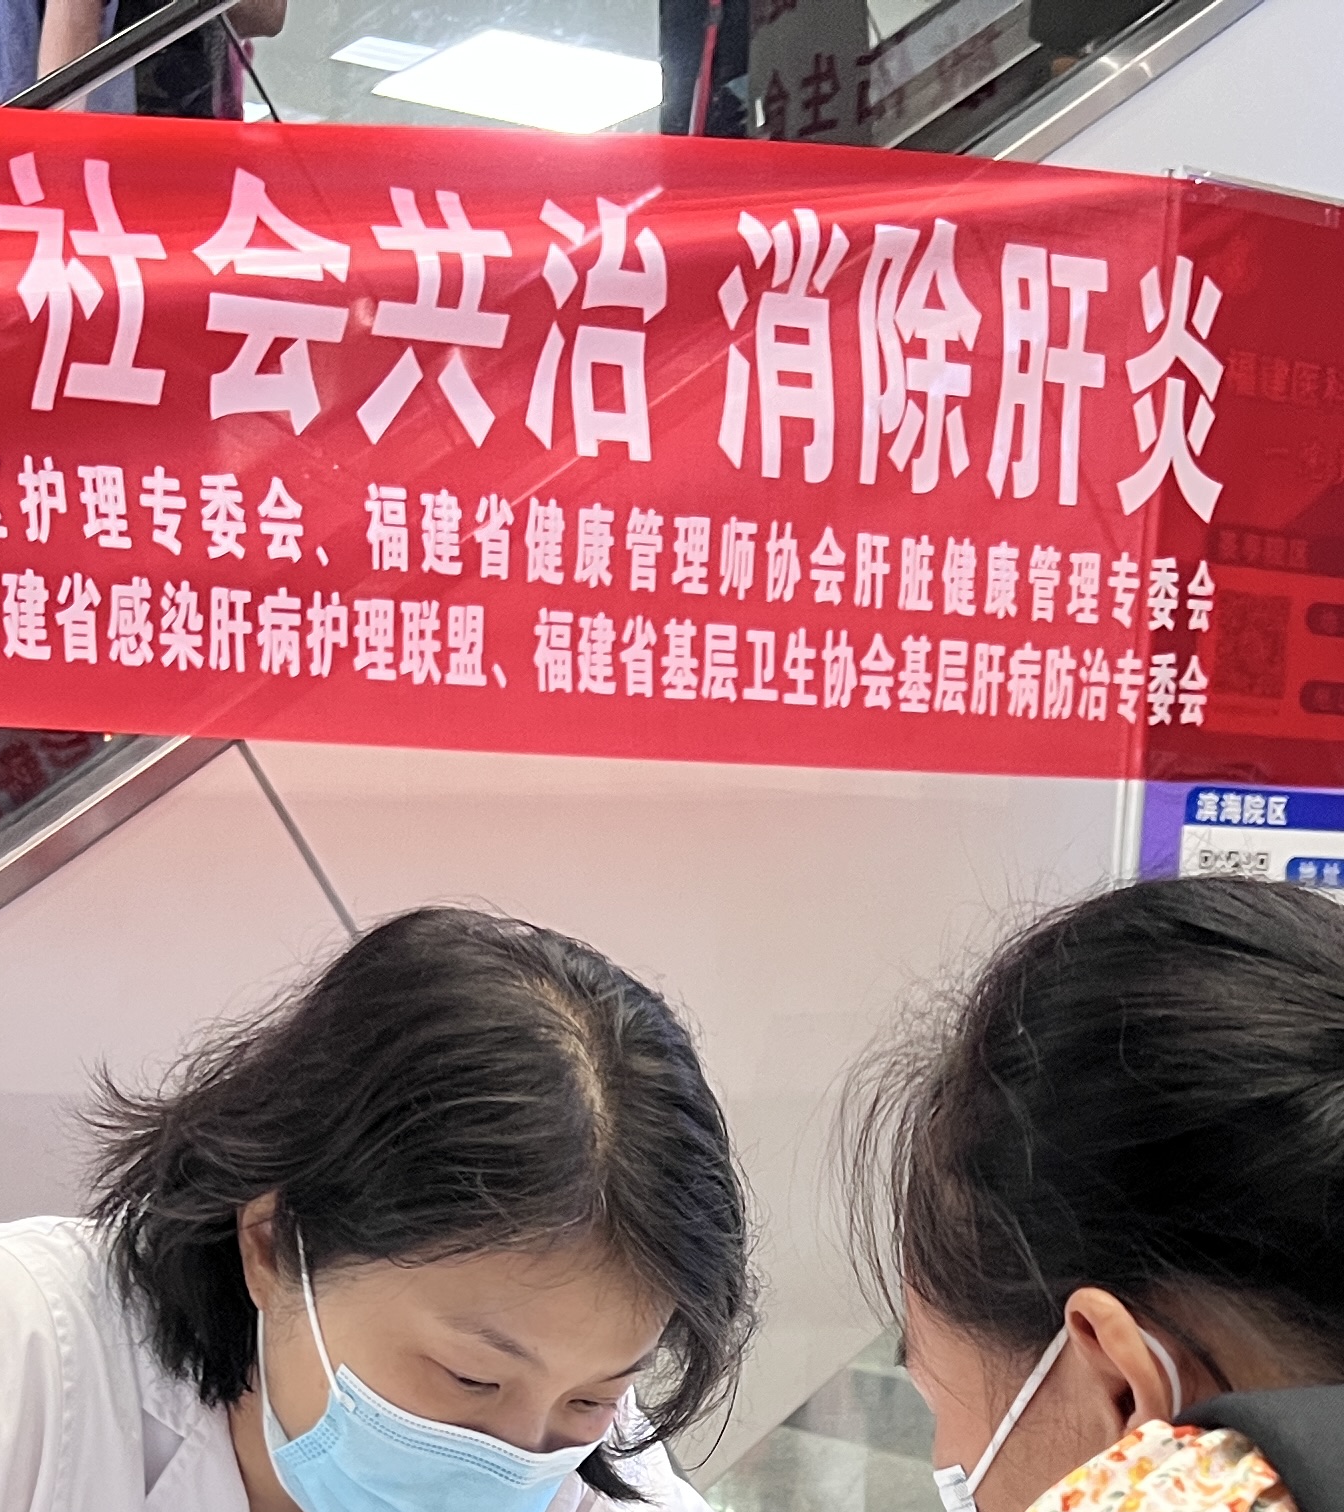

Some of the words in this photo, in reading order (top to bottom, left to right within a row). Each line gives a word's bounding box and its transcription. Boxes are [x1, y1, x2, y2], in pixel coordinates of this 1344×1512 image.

[718, 209, 1225, 522] 消除肝炎
[1195, 792, 1289, 827] 滨海院区
